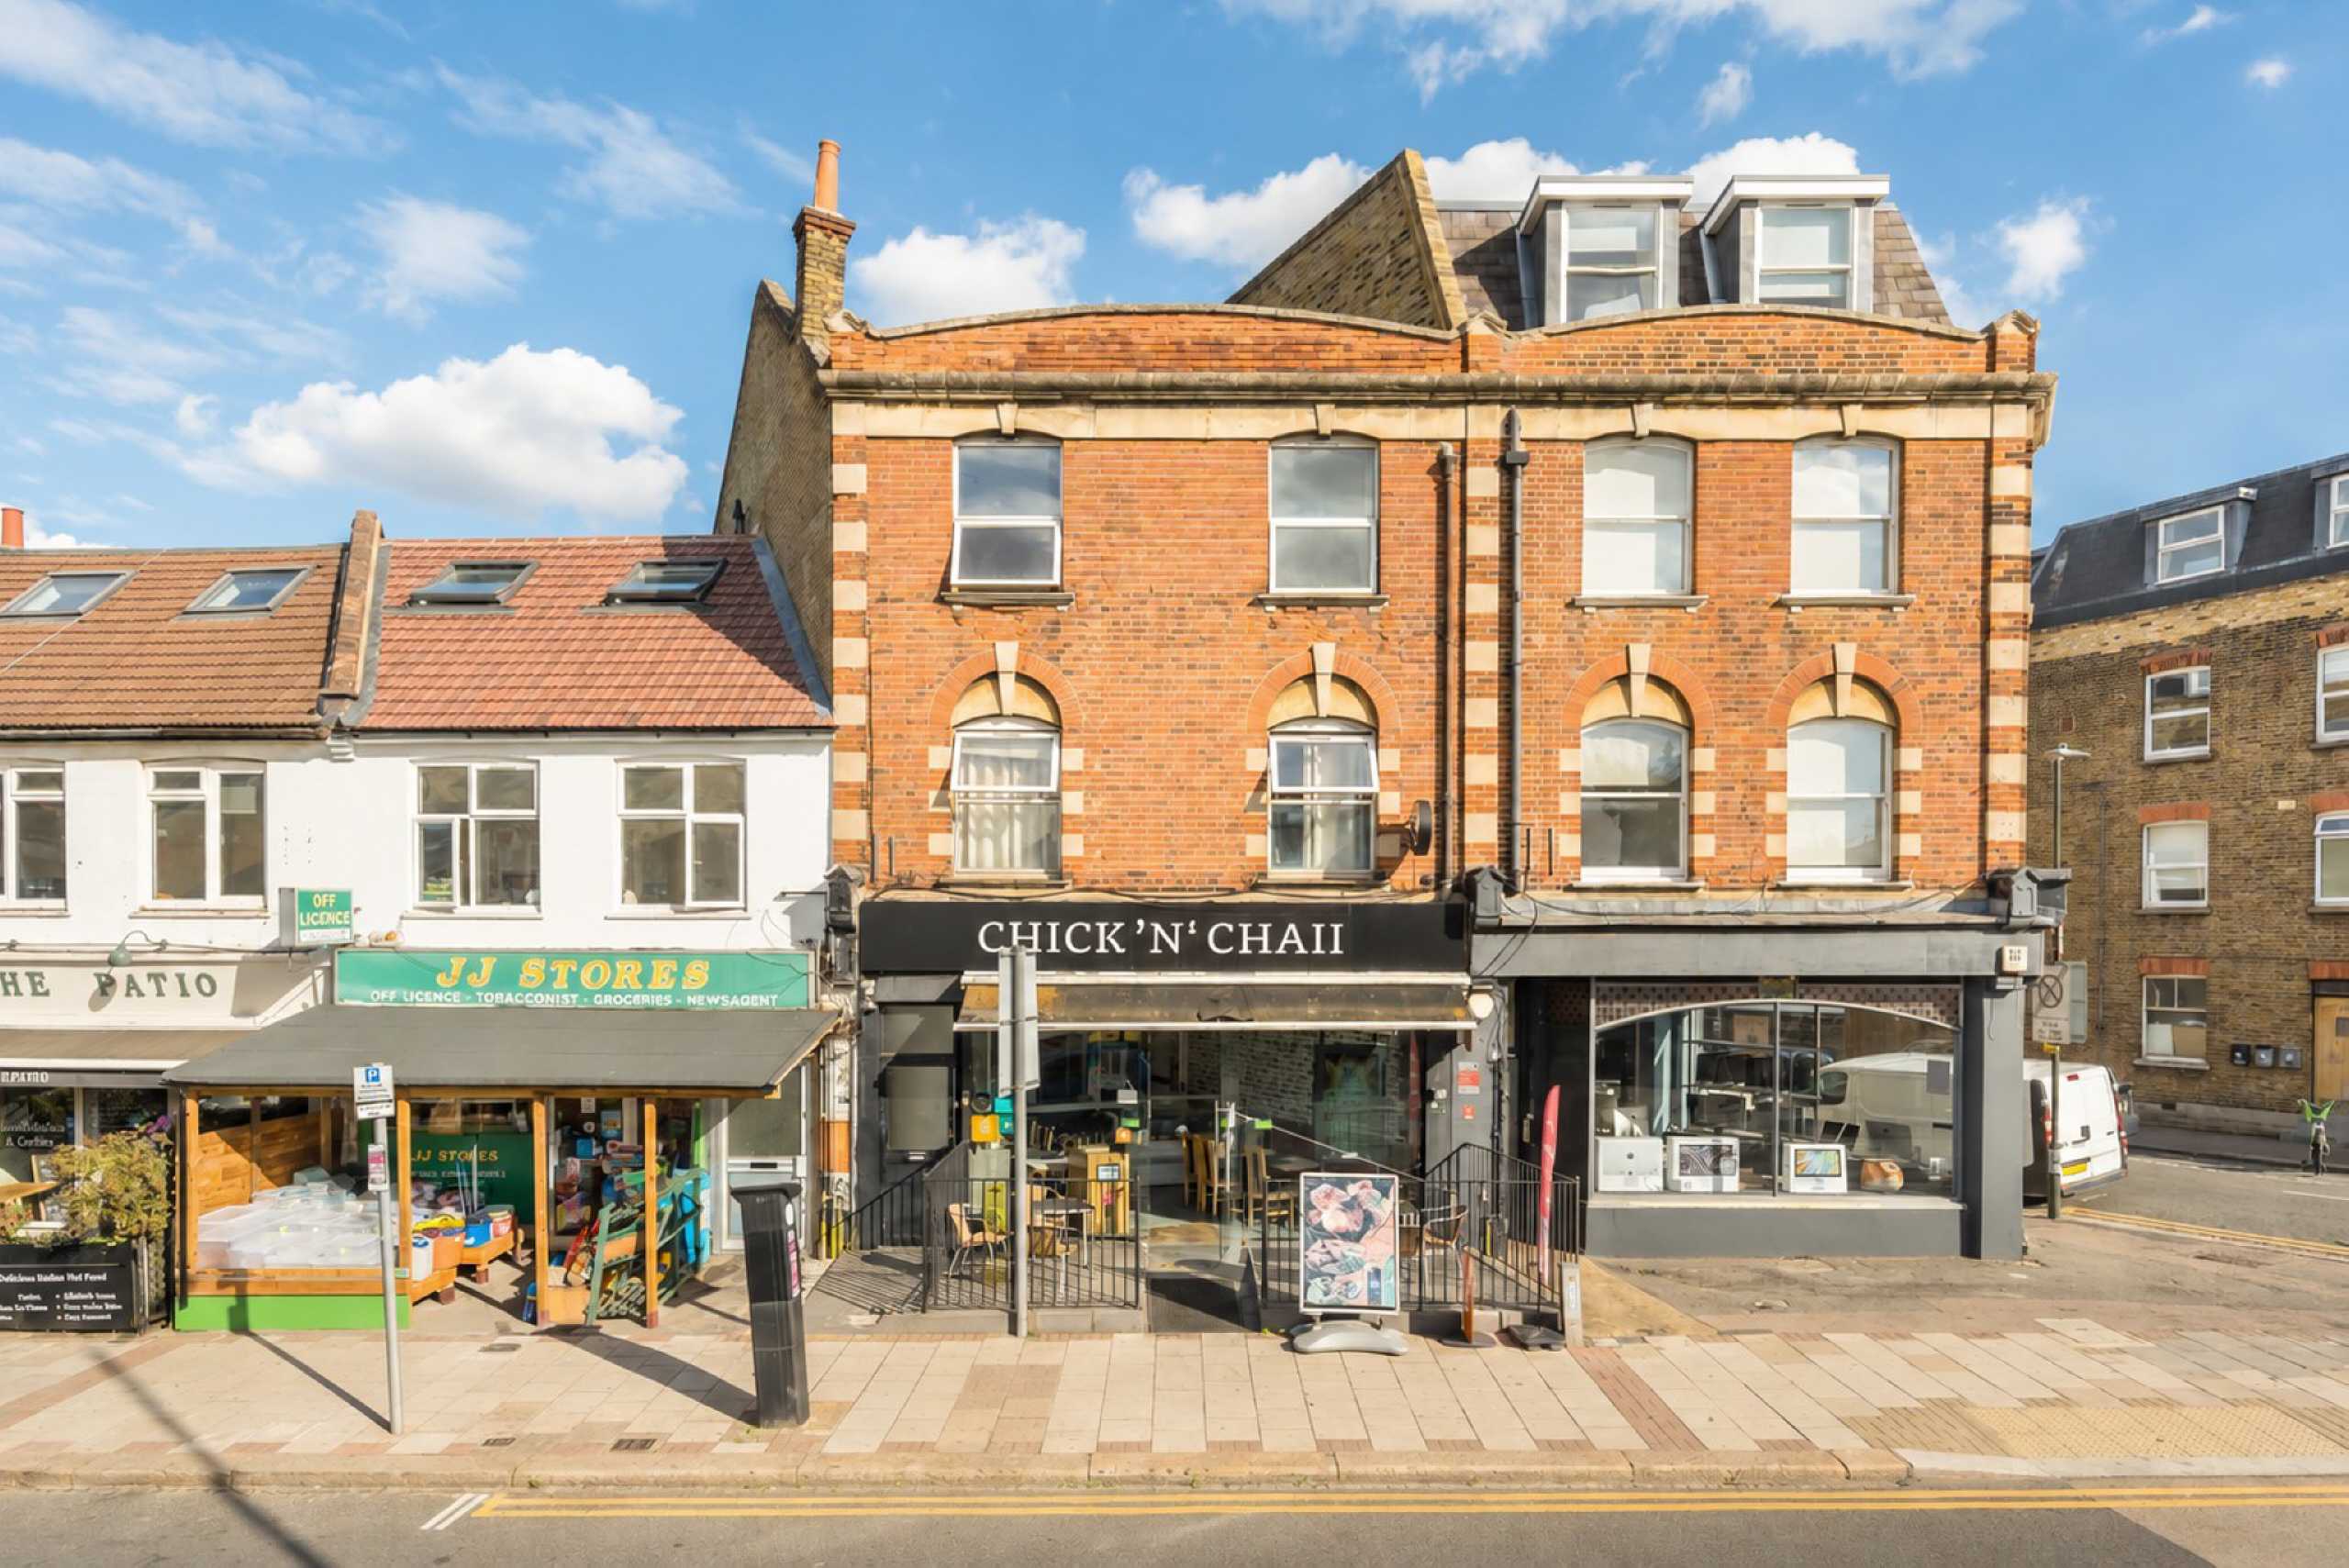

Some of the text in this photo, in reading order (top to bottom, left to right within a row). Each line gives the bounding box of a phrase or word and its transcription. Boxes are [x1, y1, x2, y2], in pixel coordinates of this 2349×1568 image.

[312, 893, 337, 908] OFF
[299, 910, 351, 926] LICENCE
[977, 920, 1127, 954] CHICK
[1207, 921, 1345, 955] CHAII
[435, 956, 710, 991] JJ STORES
[93, 972, 217, 998] PATIO
[370, 989, 398, 1004] OFF
[404, 990, 462, 1005] LICENCE
[475, 992, 579, 1006] TOBACCONIST
[594, 994, 673, 1006] GROCERIES
[686, 994, 779, 1007] NEWSAGENT
